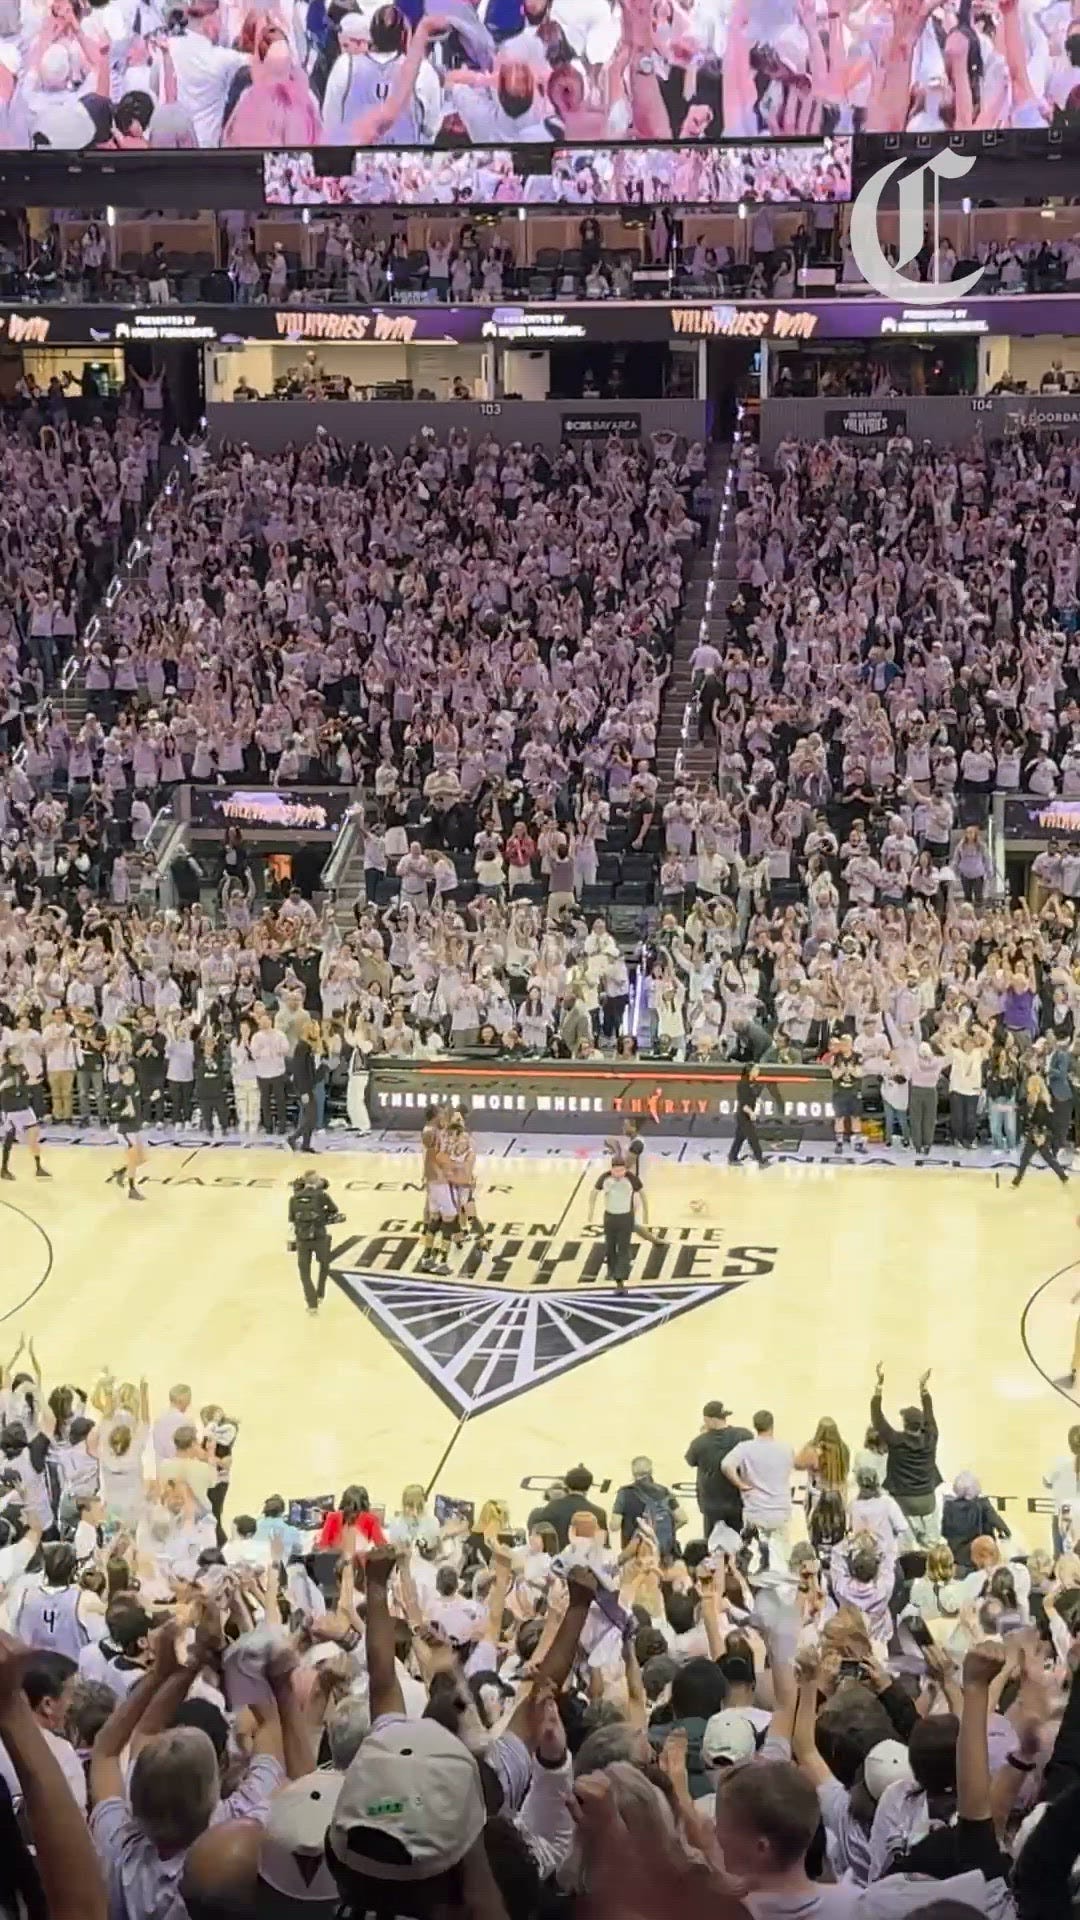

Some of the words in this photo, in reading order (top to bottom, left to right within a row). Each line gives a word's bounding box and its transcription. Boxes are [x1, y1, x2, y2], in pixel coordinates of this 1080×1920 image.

[374, 313, 417, 343] WIN
[773, 309, 818, 338] WIN
[480, 403, 501, 415] 103
[973, 400, 993, 411] 104
[471, 1095, 526, 1110] MORE
[536, 1096, 603, 1112] WHERE
[344, 1181, 514, 1195] CENR
[580, 1222, 725, 1242] STE
[43, 1610, 55, 1633] 4
